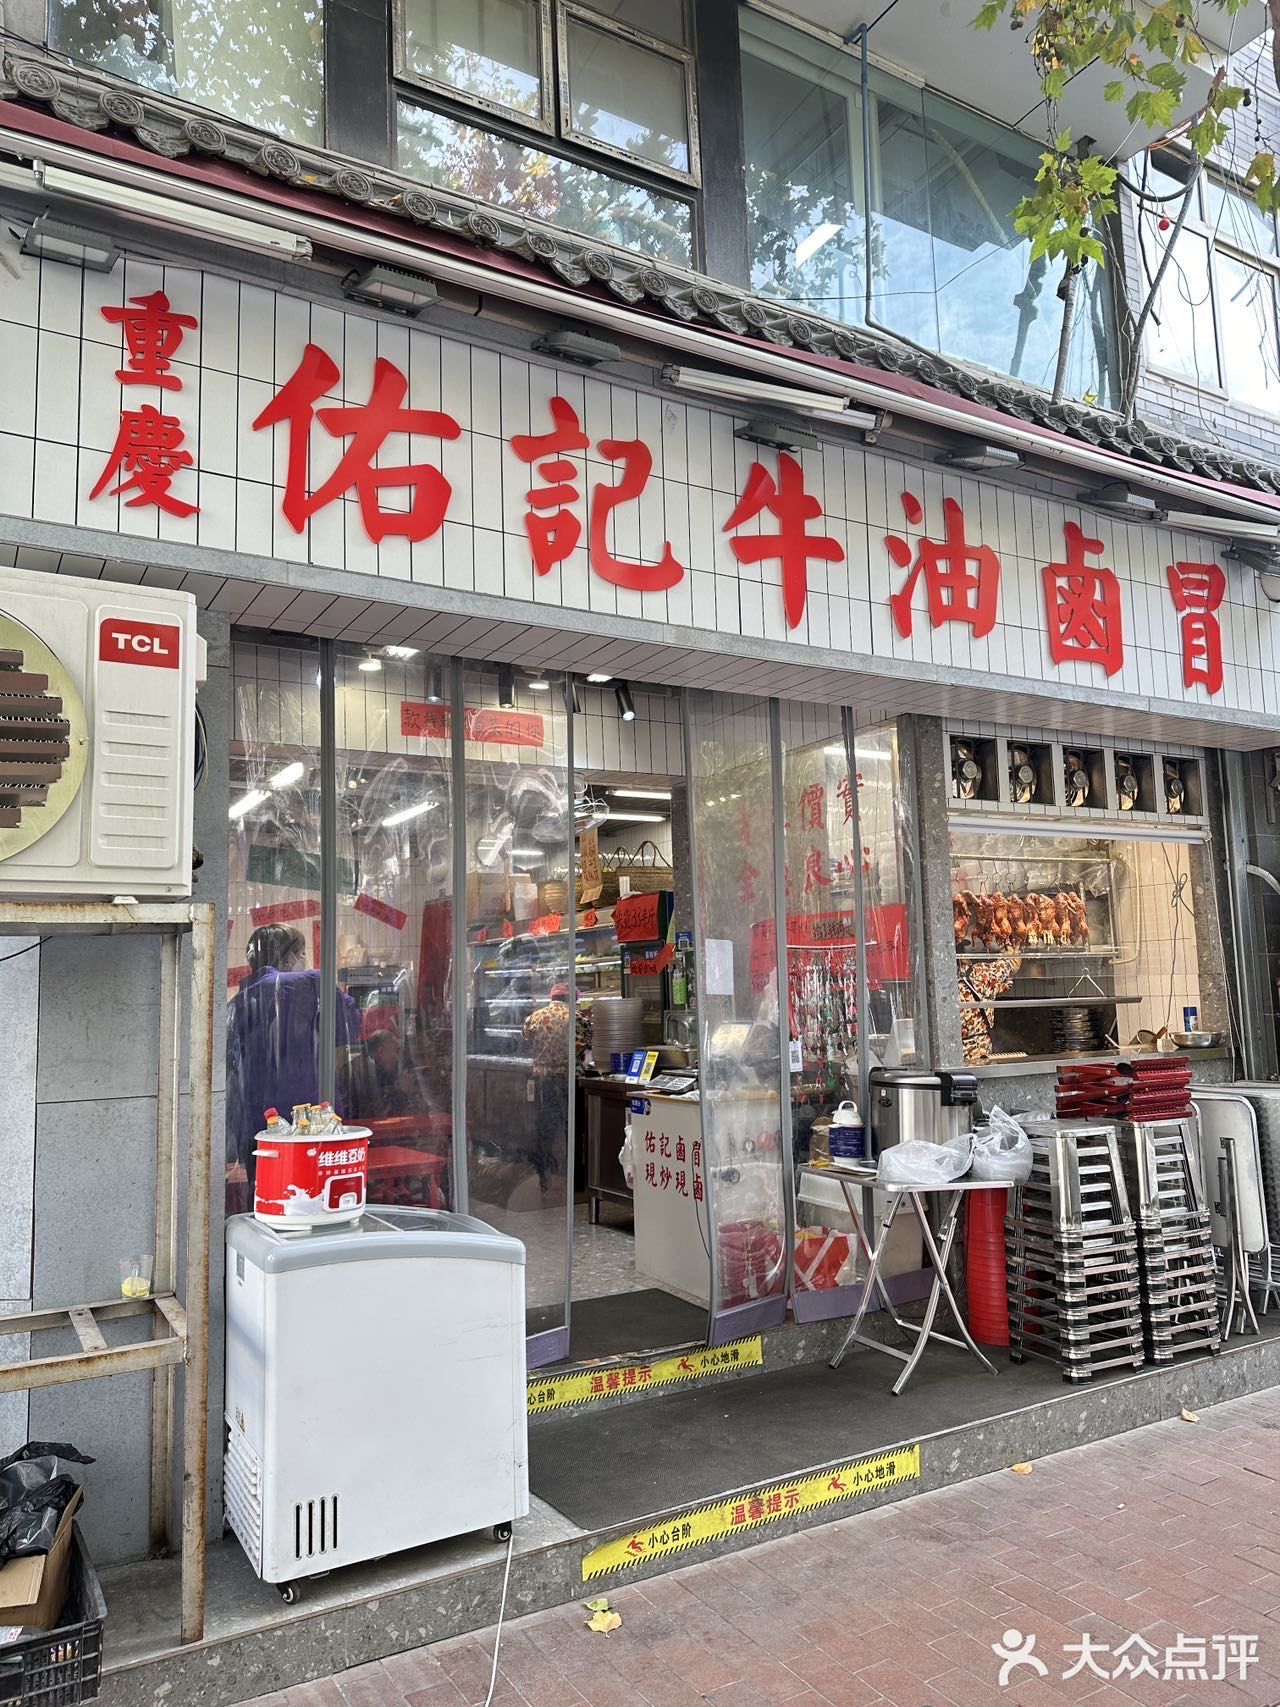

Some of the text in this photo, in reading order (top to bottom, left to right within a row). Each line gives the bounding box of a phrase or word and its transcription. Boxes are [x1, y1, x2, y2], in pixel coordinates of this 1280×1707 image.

[90, 290, 201, 518] 重慶
[111, 632, 168, 655] TCL
[318, 1147, 365, 1167] 维维豆奶
[645, 1131, 703, 1168] 佑記鹵冒
[645, 1162, 703, 1202] 現炒現鹵
[590, 1366, 653, 1394] 温馨提示
[700, 1348, 740, 1369] 小心地滑
[647, 1461, 896, 1549] 小心台阶 温馨提示 小心地滑
